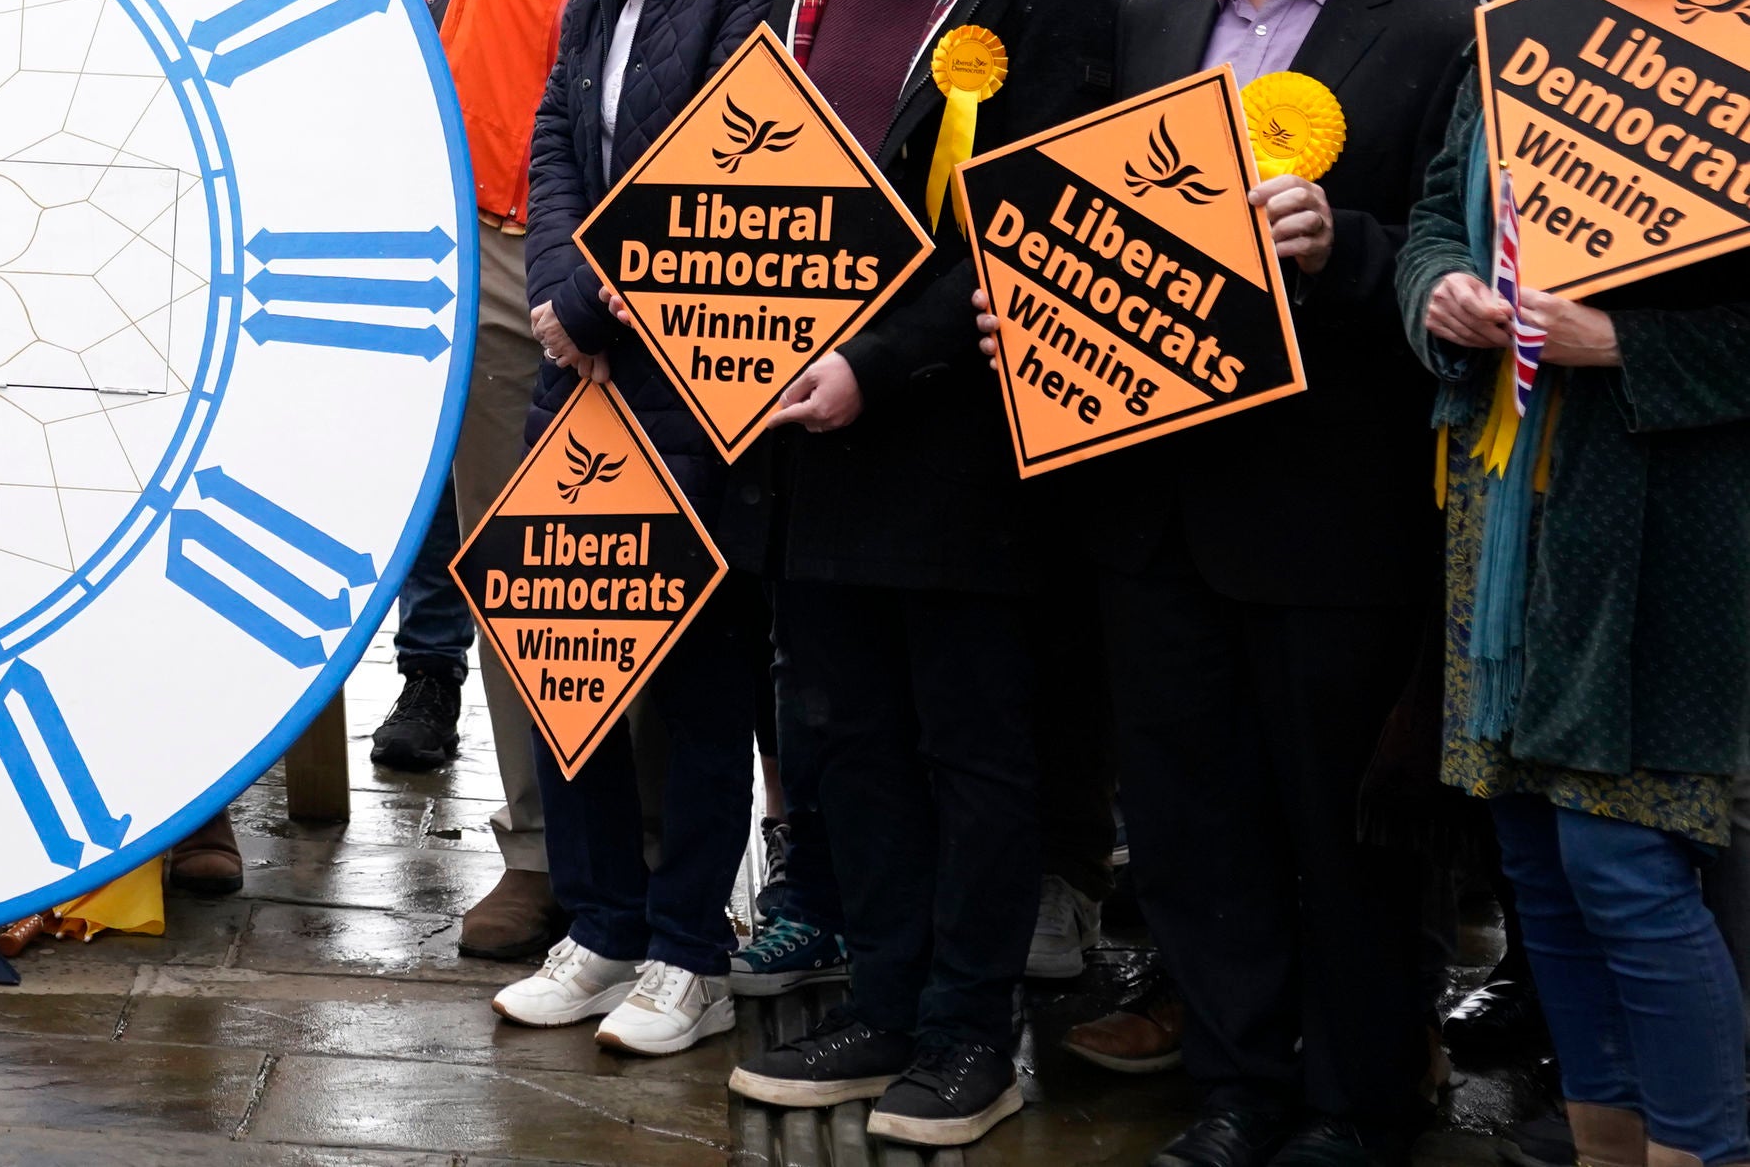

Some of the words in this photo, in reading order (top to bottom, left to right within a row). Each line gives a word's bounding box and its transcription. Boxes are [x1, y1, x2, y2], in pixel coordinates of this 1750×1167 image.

[1578, 16, 1750, 144] Libera
[1515, 121, 1687, 247] Winning
[668, 192, 834, 242] Liberal
[1518, 181, 1615, 259] here
[619, 239, 880, 291] Democrats
[1049, 184, 1227, 322] Liberal
[984, 199, 1246, 395] Democrats
[660, 302, 817, 353] Winning
[1006, 283, 1160, 418] Winning
[691, 345, 775, 384] here
[1016, 344, 1102, 425] here
[523, 521, 651, 567] Liberal
[484, 569, 686, 612] Democrats
[516, 627, 637, 673] Winning
[539, 668, 605, 702] here
